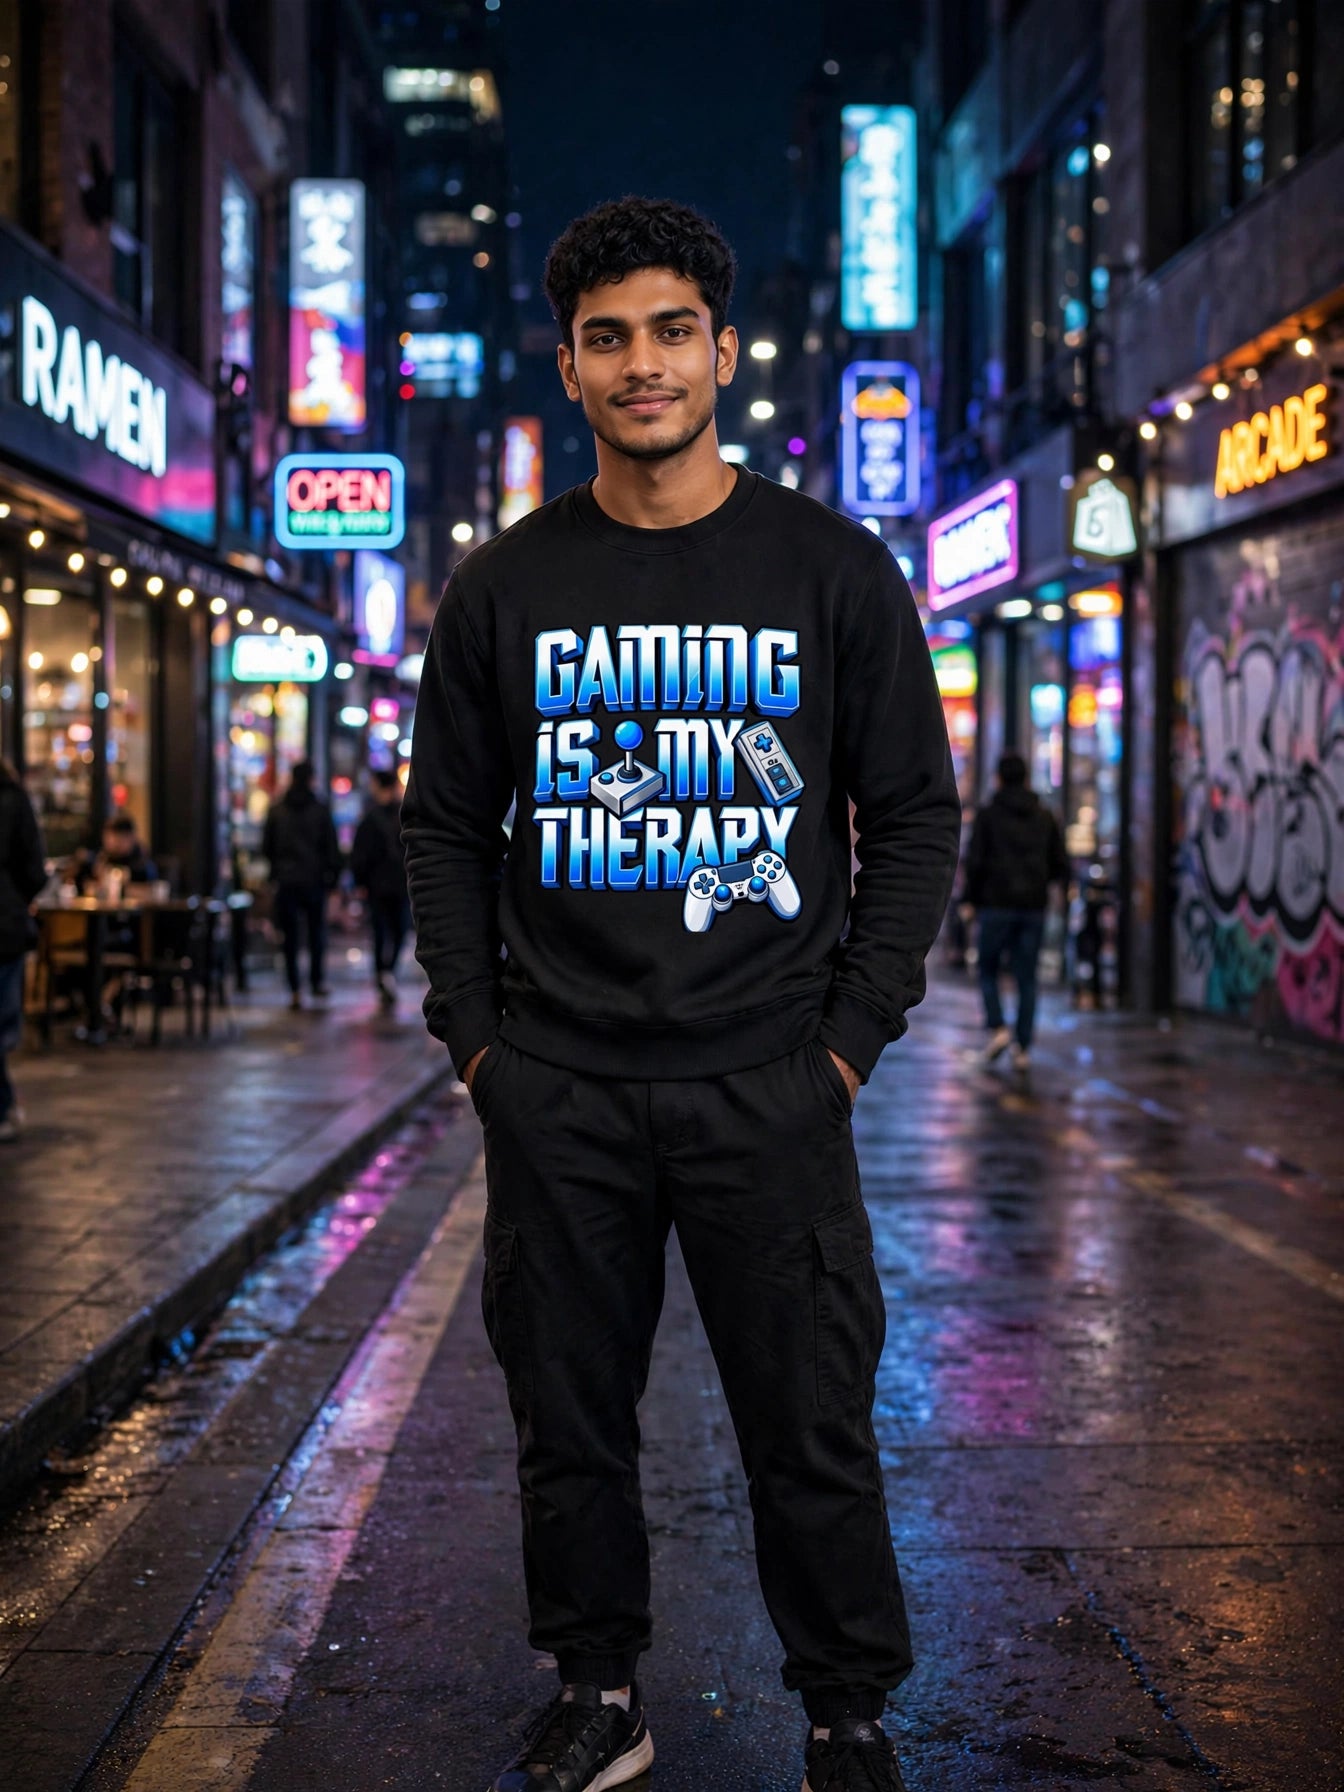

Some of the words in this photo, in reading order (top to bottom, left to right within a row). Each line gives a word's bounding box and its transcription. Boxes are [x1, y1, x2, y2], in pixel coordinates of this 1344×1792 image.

[23, 295, 166, 478] RAMEN
[1214, 384, 1328, 499] ARCADE
[287, 469, 391, 513] OPEN
[654, 718, 746, 800] MY
[533, 806, 800, 891] THERAPY
